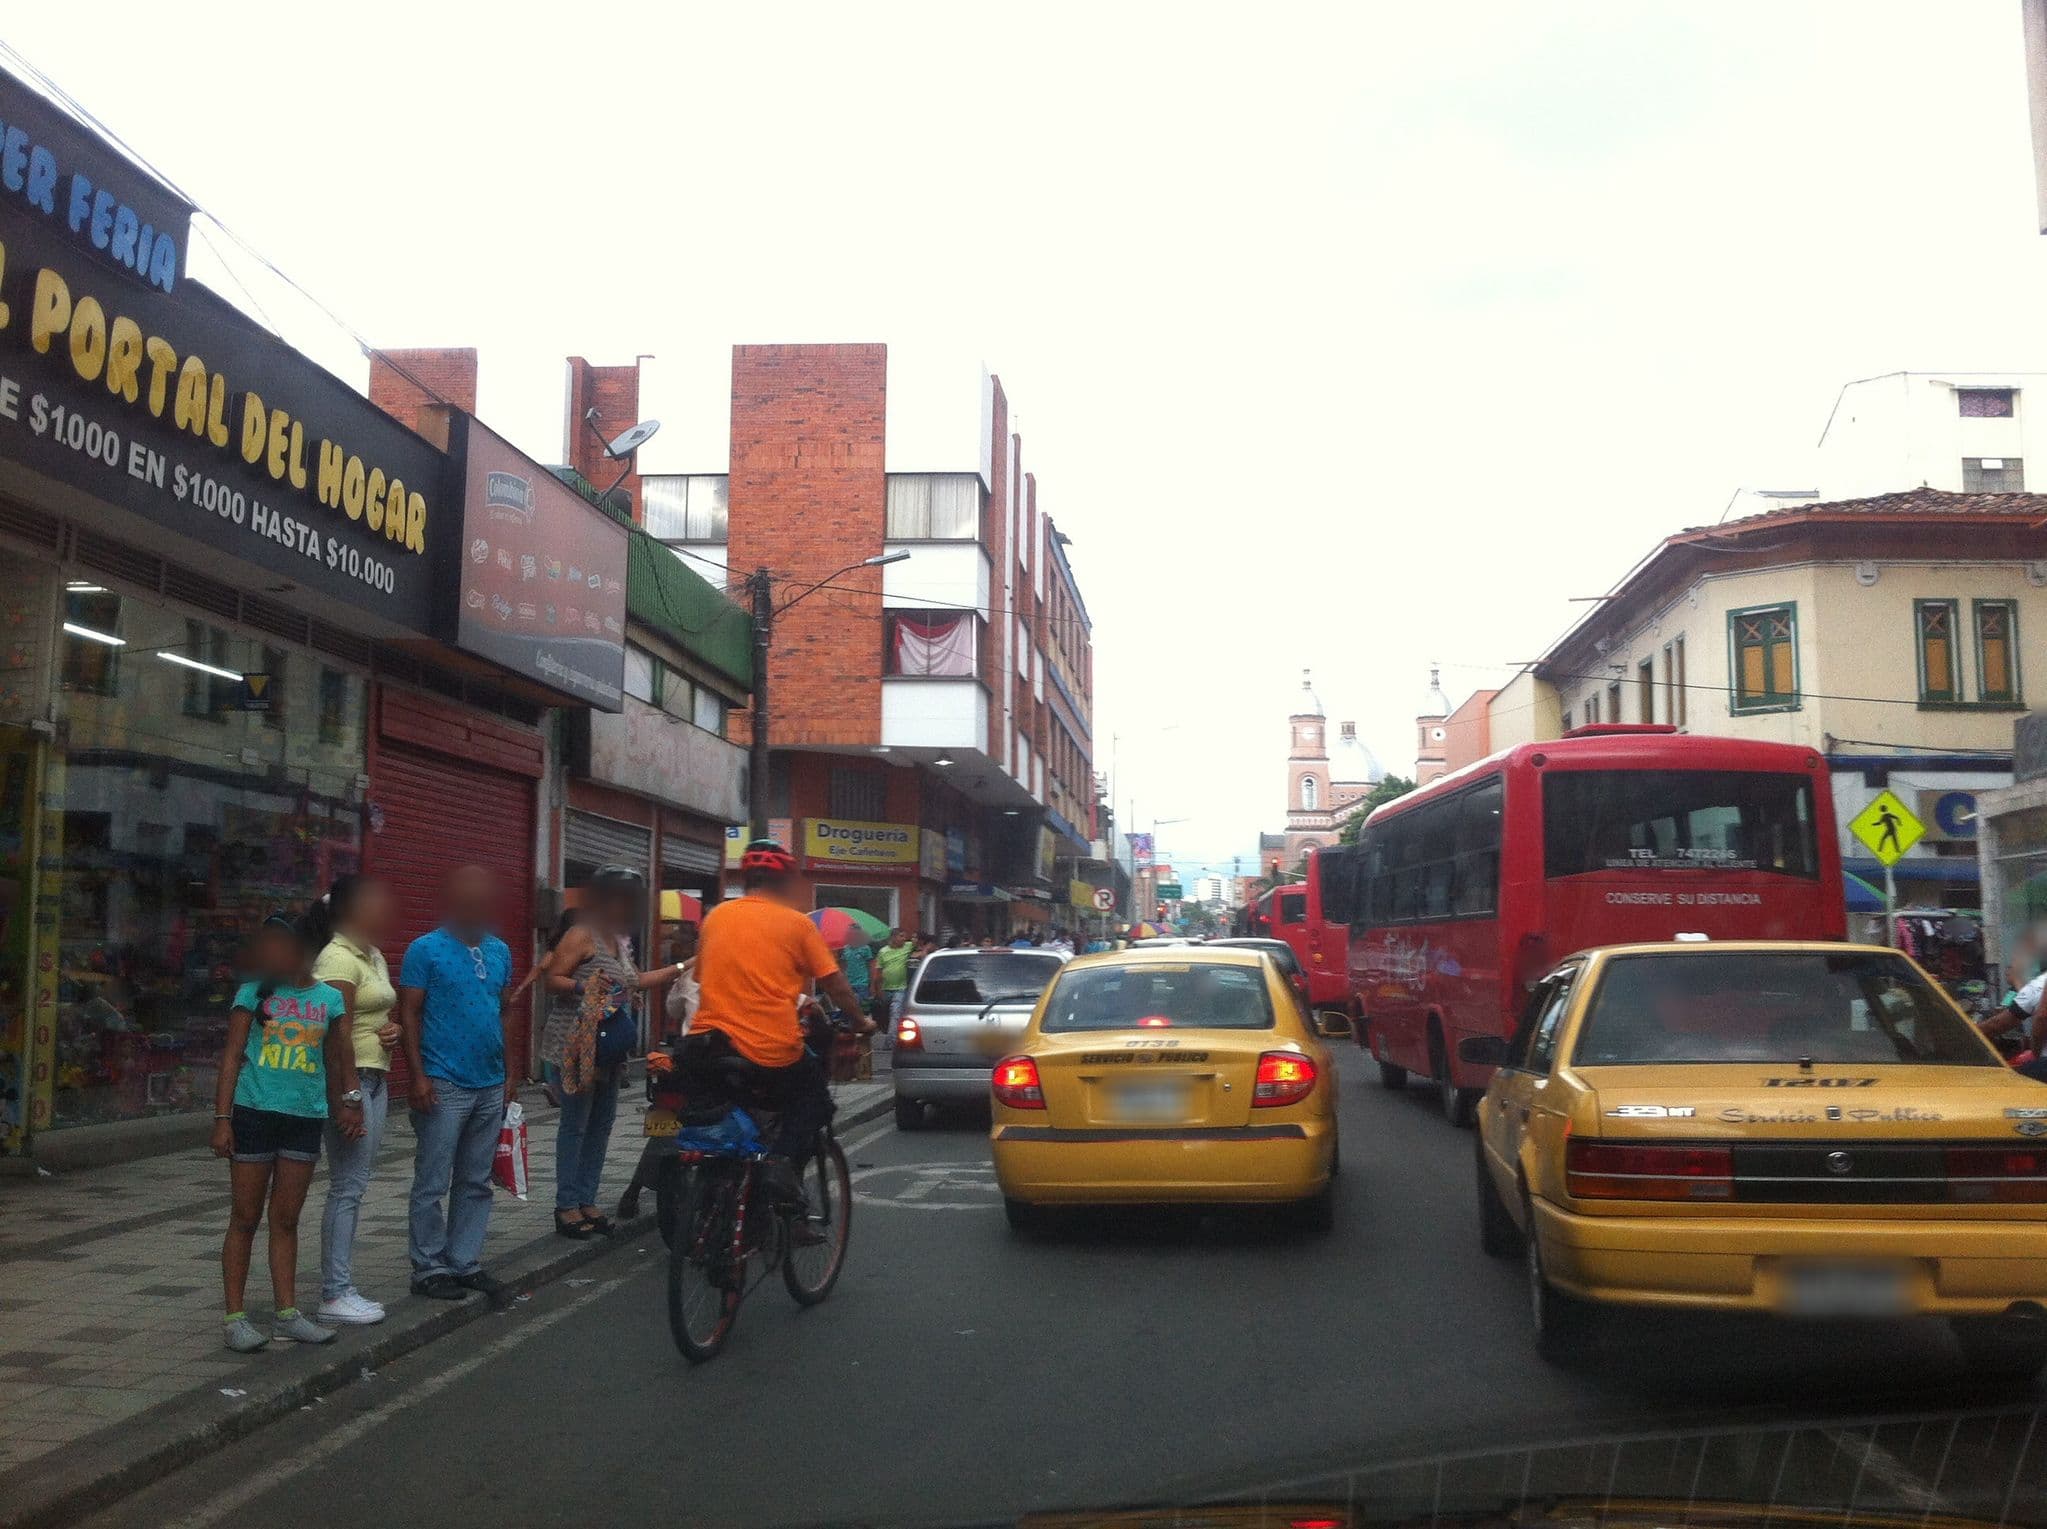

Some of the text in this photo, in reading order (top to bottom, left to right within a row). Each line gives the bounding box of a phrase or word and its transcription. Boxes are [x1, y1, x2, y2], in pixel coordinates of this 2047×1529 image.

[0, 119, 57, 215] ER
[68, 173, 176, 294] FERIA
[32, 268, 228, 447] PORTAL
[242, 392, 306, 489] DEL
[318, 439, 426, 555] HOGAR
[29, 393, 120, 466] $1.000
[128, 441, 166, 488] EN
[173, 463, 245, 525] $1.000
[252, 501, 320, 561] HASTA
[326, 537, 394, 594] $10.000
[1605, 892, 1672, 904] CONSERVE
[1697, 893, 1762, 905] DISTANCIA
[1628, 849, 1656, 858] TEL
[1080, 1053, 1134, 1064] SERVICIO
